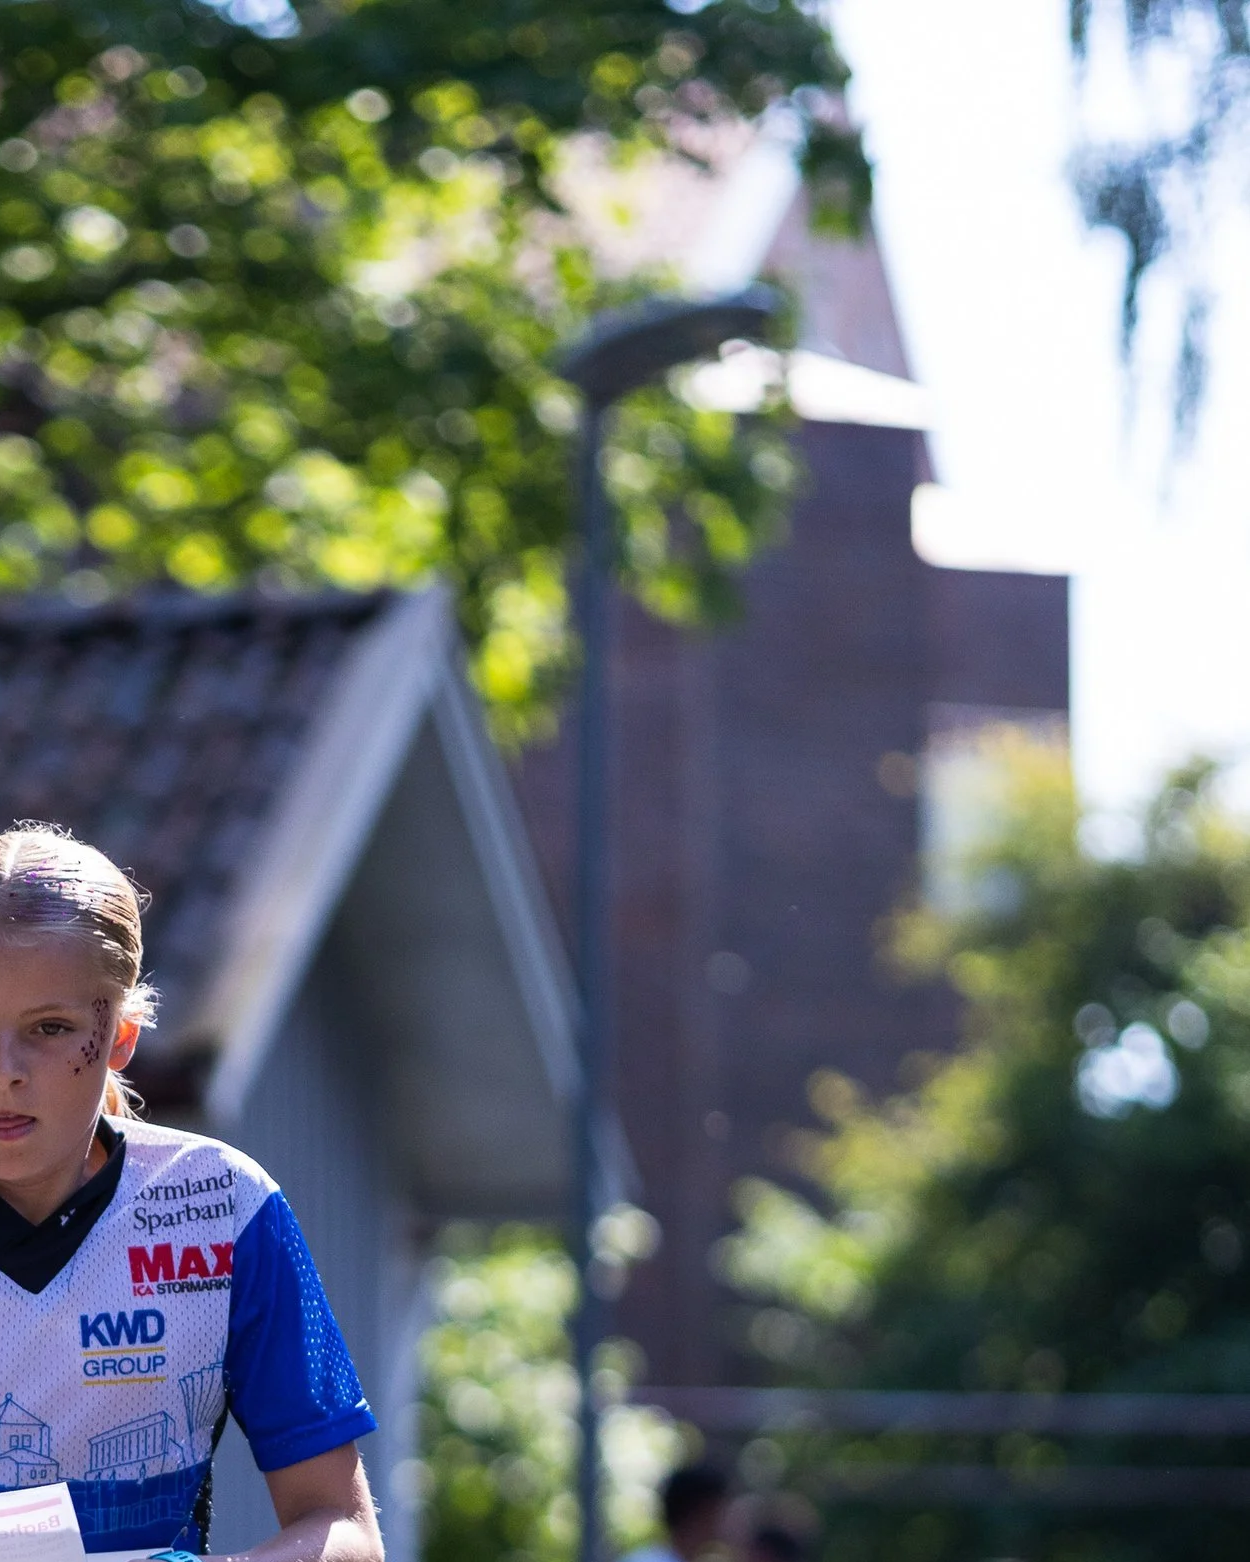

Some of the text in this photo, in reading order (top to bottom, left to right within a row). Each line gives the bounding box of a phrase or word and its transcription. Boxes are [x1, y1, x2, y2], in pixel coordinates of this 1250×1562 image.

[127, 1241, 233, 1283] MAX
[133, 1285, 154, 1296] ICA
[80, 1309, 165, 1348] KWD
[83, 1355, 166, 1376] GROUP
